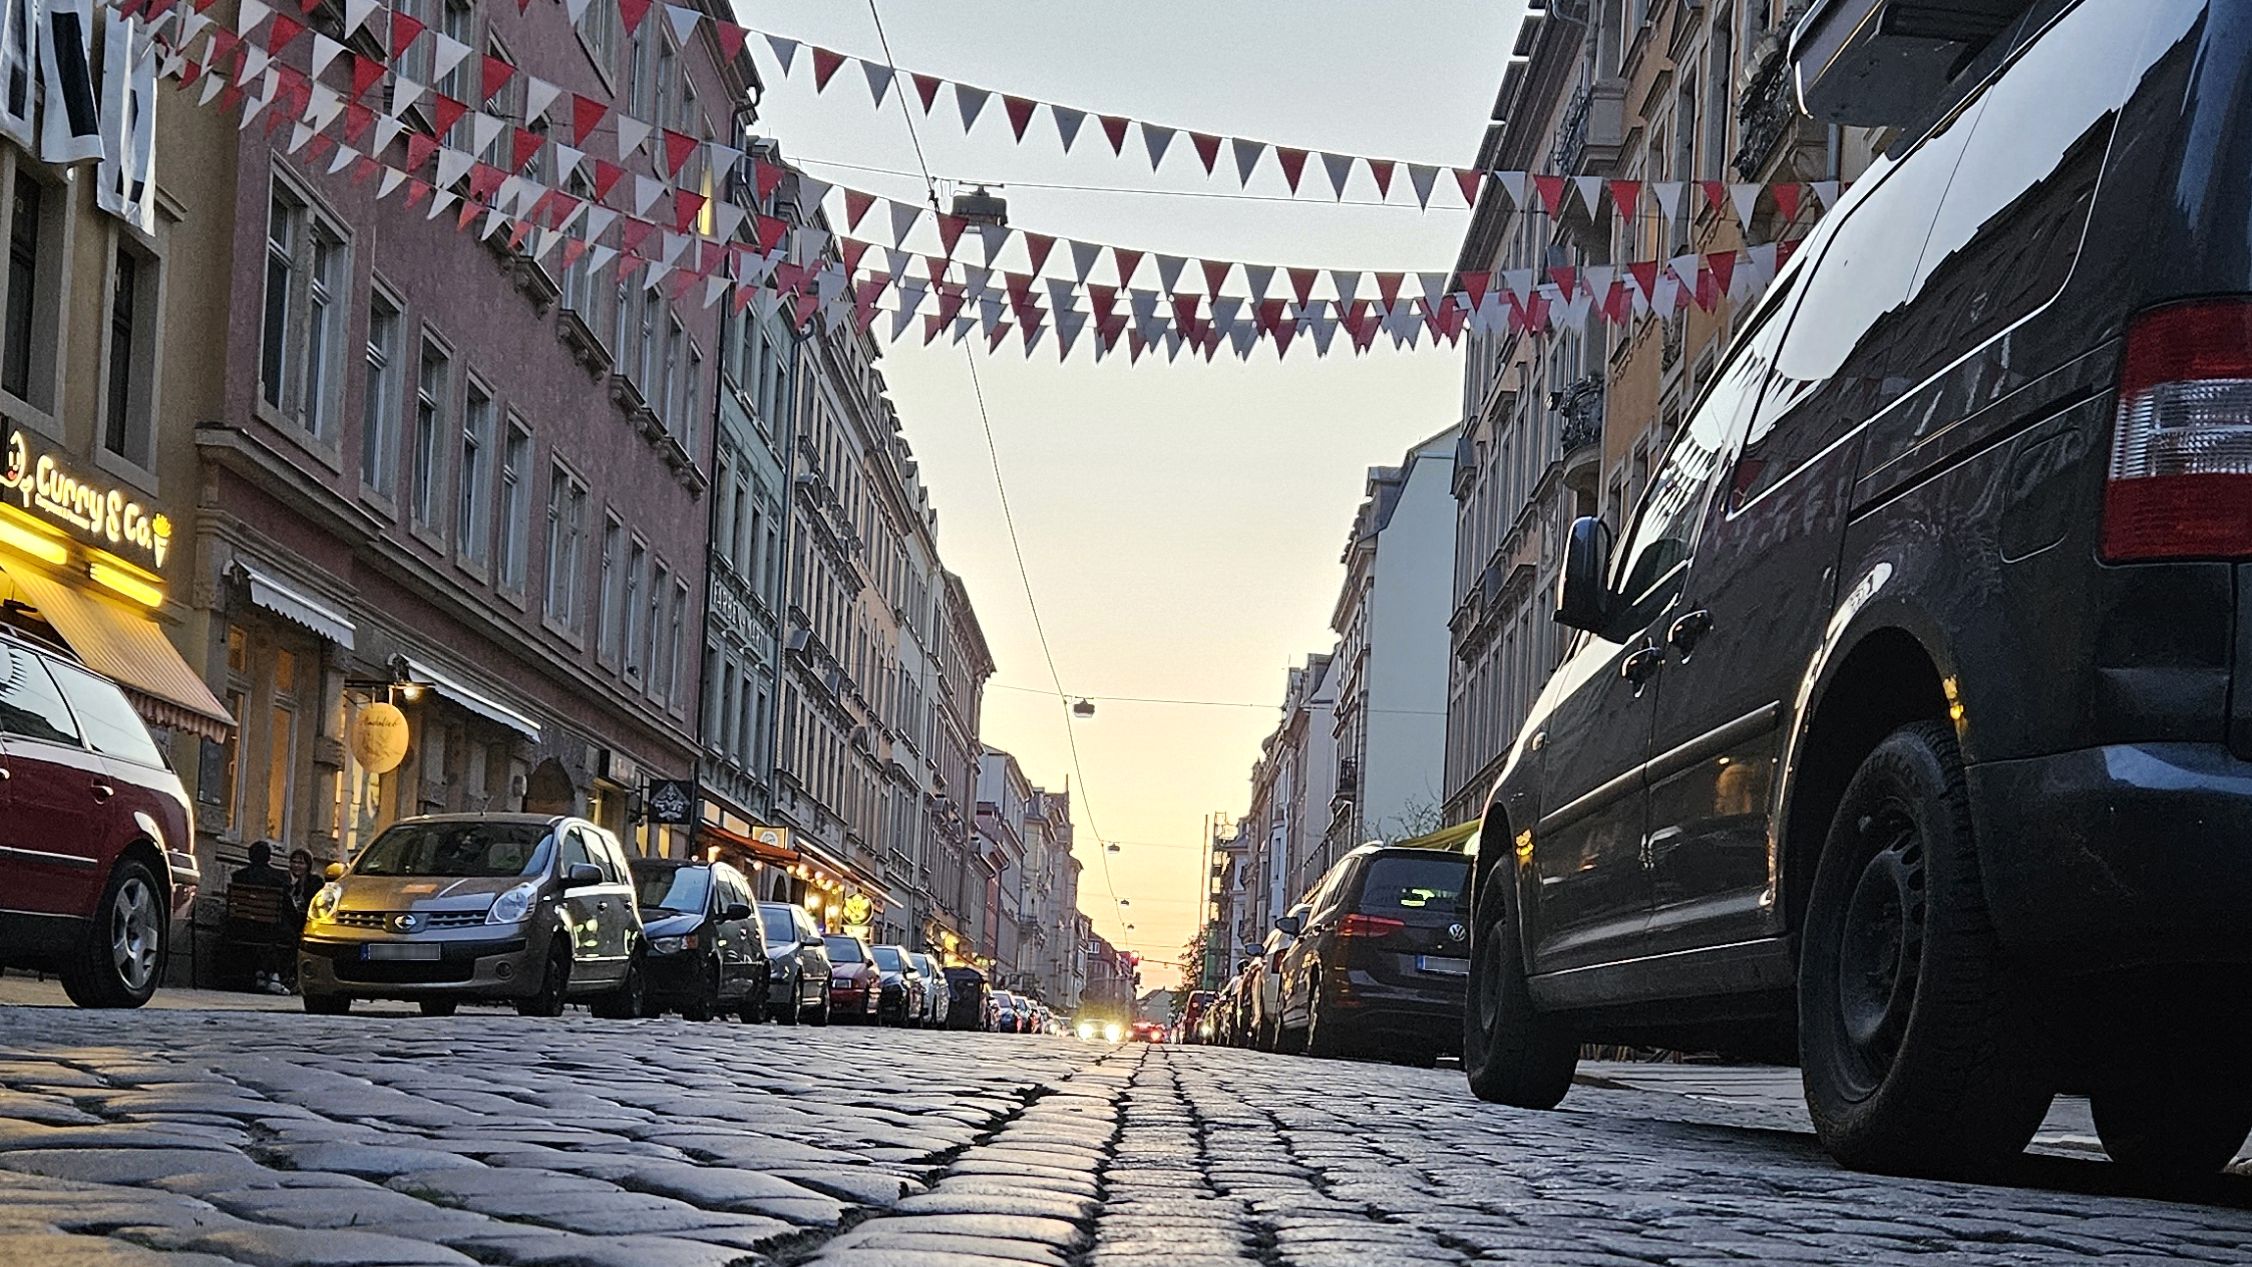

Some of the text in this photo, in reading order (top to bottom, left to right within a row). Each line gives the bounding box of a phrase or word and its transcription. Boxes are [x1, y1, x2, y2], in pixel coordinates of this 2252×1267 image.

[36, 455, 104, 533] Curry
[106, 490, 122, 543] &
[124, 503, 152, 550] Co.
